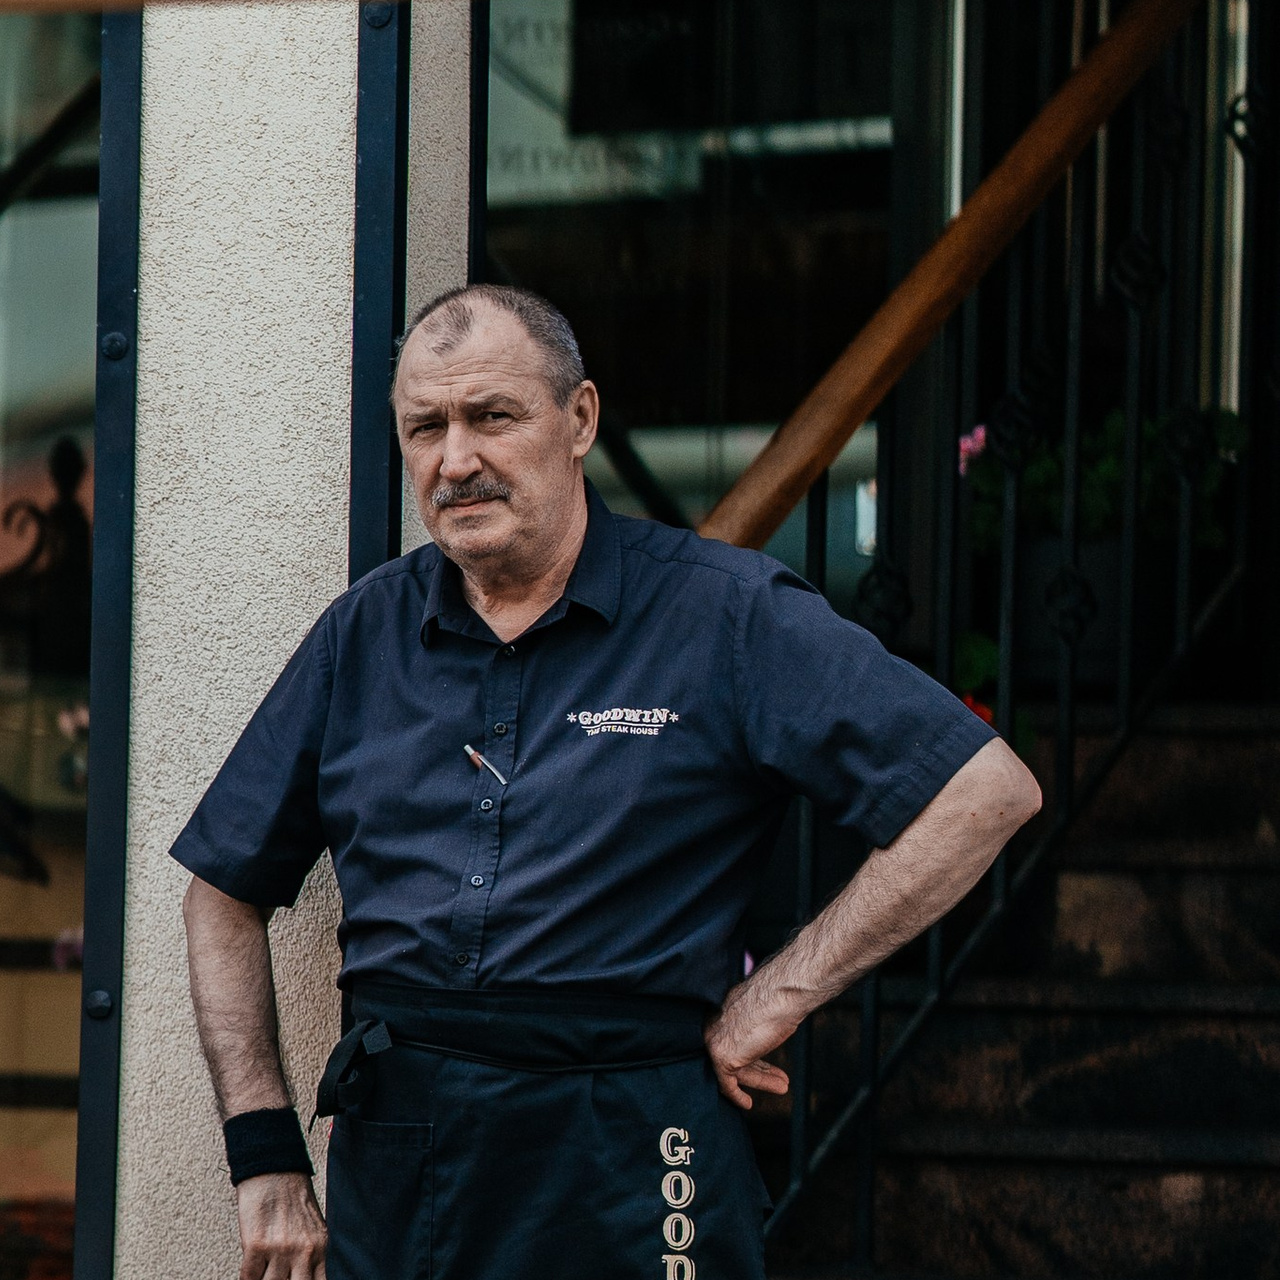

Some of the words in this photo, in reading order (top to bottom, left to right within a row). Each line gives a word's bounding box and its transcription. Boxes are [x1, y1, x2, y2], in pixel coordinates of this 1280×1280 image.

[578, 708, 670, 725] GOODWIN
[601, 725, 629, 734] STEAK
[630, 727, 659, 736] HOUSE
